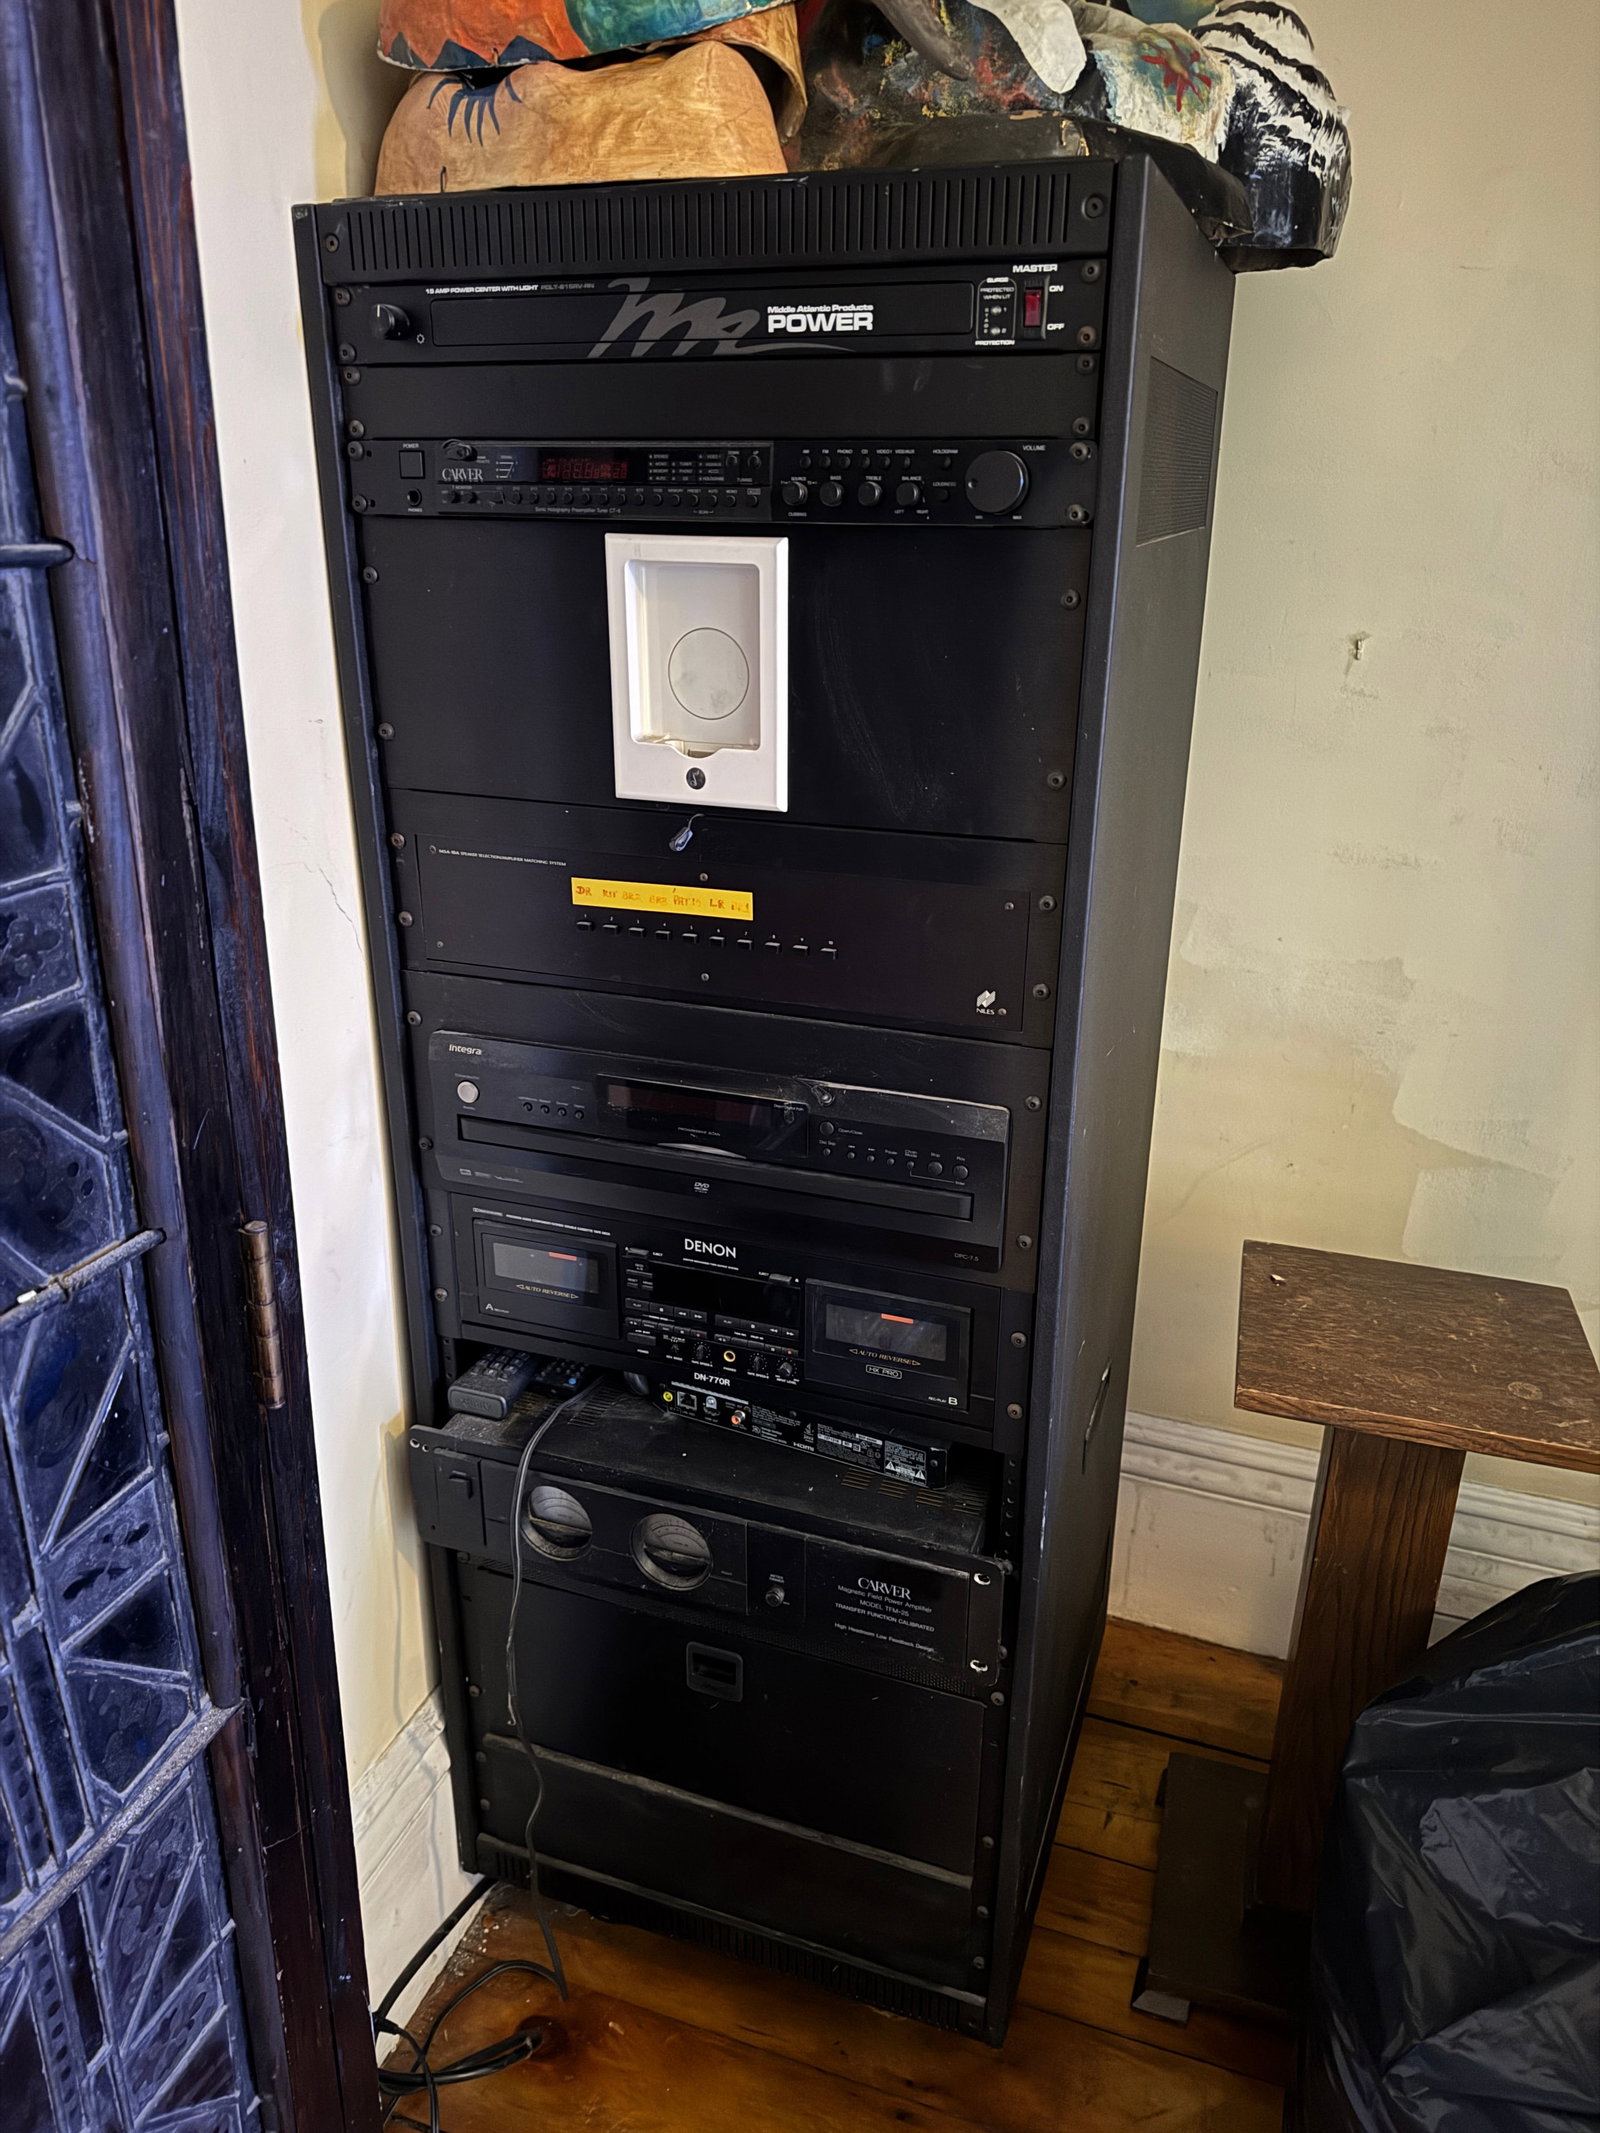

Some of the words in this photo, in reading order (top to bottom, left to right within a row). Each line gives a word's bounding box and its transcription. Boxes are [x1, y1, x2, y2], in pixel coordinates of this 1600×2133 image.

[1012, 264, 1058, 273] MASTER
[832, 304, 874, 312] Products
[768, 312, 873, 333] POWER
[1047, 323, 1065, 331] OFF
[442, 468, 483, 482] CARVER
[709, 898, 725, 910] LR
[976, 1007, 995, 1015] NILES
[449, 1044, 482, 1056] Integra
[694, 1181, 710, 1189] DVD
[684, 1238, 736, 1259] DENON
[523, 1285, 542, 1293] AUTO
[542, 1288, 571, 1298] REVERSE
[485, 1303, 494, 1311] A
[857, 1350, 878, 1358] AUTO
[879, 1354, 912, 1365] REVERSE
[882, 1368, 899, 1378] PRO
[694, 1372, 730, 1386] DN-770R
[948, 1396, 958, 1405] B
[793, 1441, 815, 1452] HDMI
[858, 1577, 911, 1600] CARVER
[838, 1584, 866, 1597] Magnetic
[867, 1592, 883, 1601] Field
[884, 1596, 903, 1606] Power
[905, 1601, 932, 1614] Amplifier
[860, 1600, 884, 1611] MODEL
[835, 1602, 866, 1615] TRANSFER
[867, 1610, 897, 1623] FUNCTION
[898, 1617, 935, 1632] CALIBRATED
[835, 1622, 847, 1631] High
